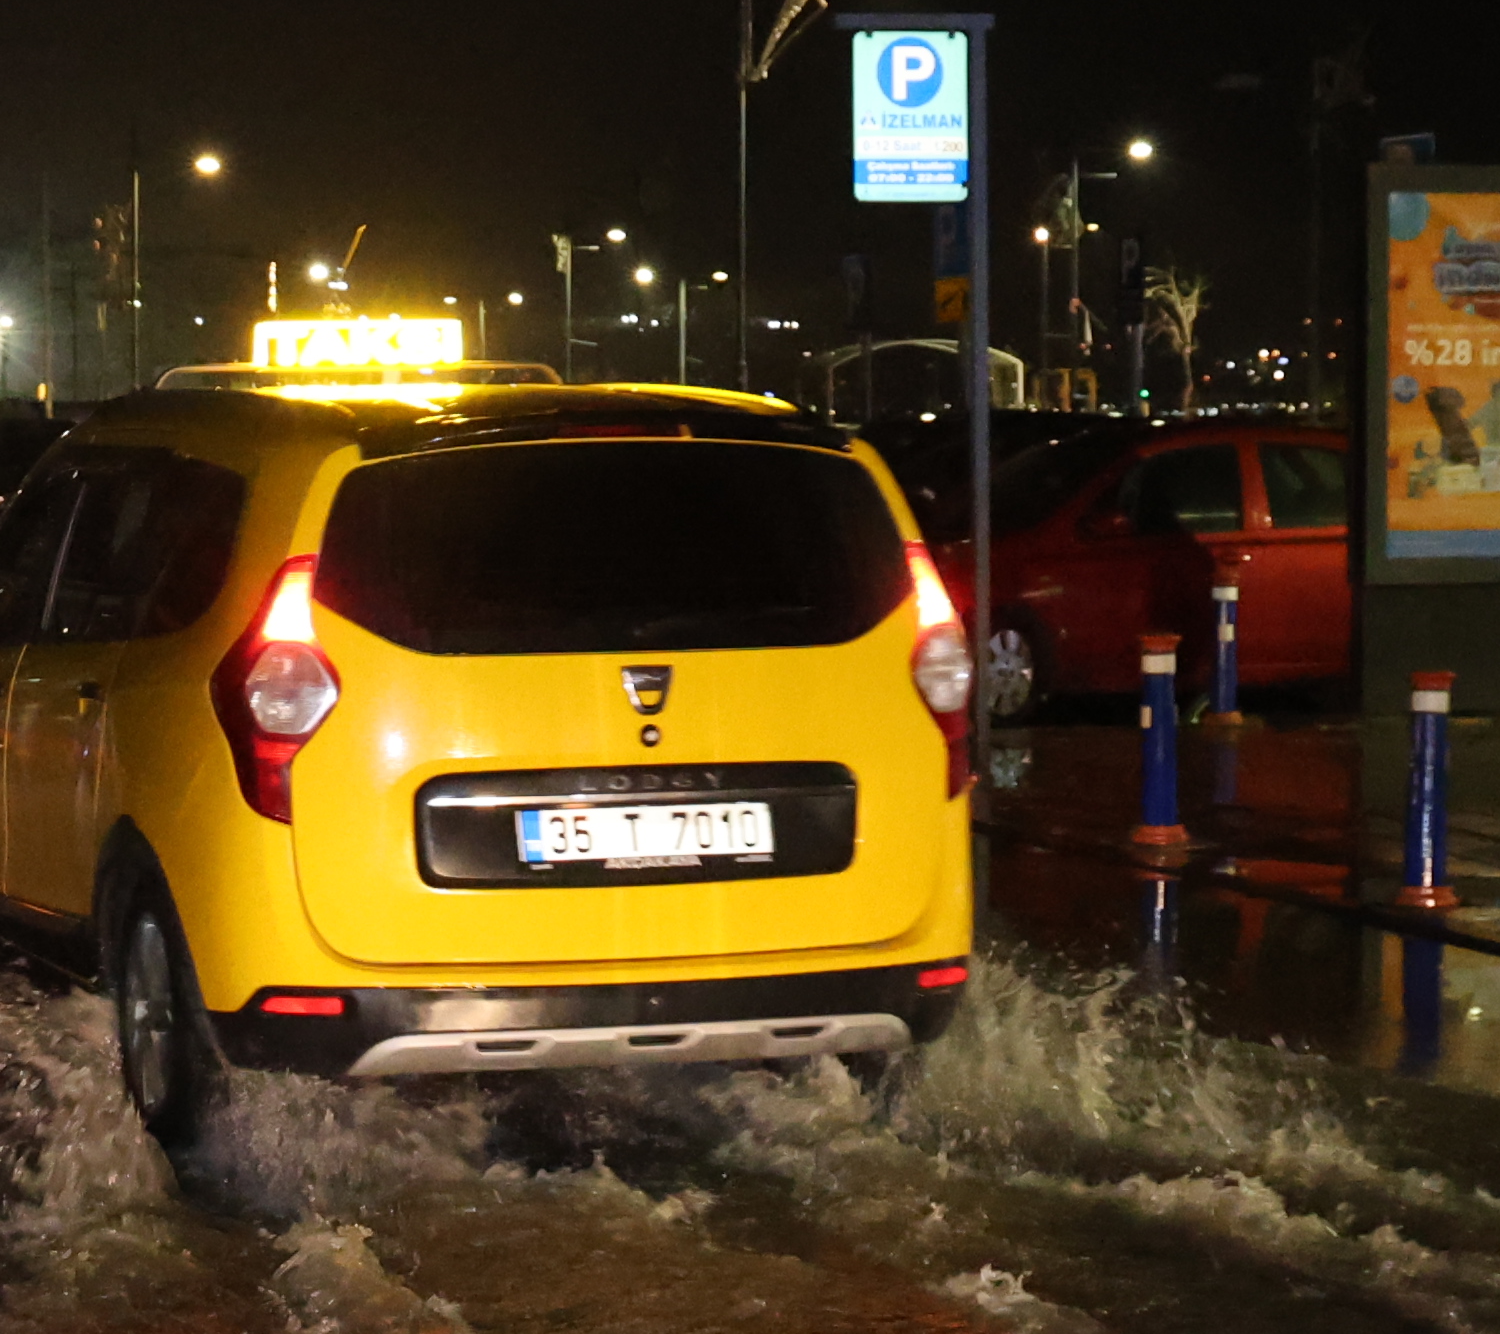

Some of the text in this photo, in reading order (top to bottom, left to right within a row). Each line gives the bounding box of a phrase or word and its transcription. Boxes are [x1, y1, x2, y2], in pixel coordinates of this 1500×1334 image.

[890, 45, 936, 101] P
[882, 112, 962, 129] İZELMAN
[1404, 338, 1473, 366] %28
[548, 809, 759, 854] 35 T 7010
